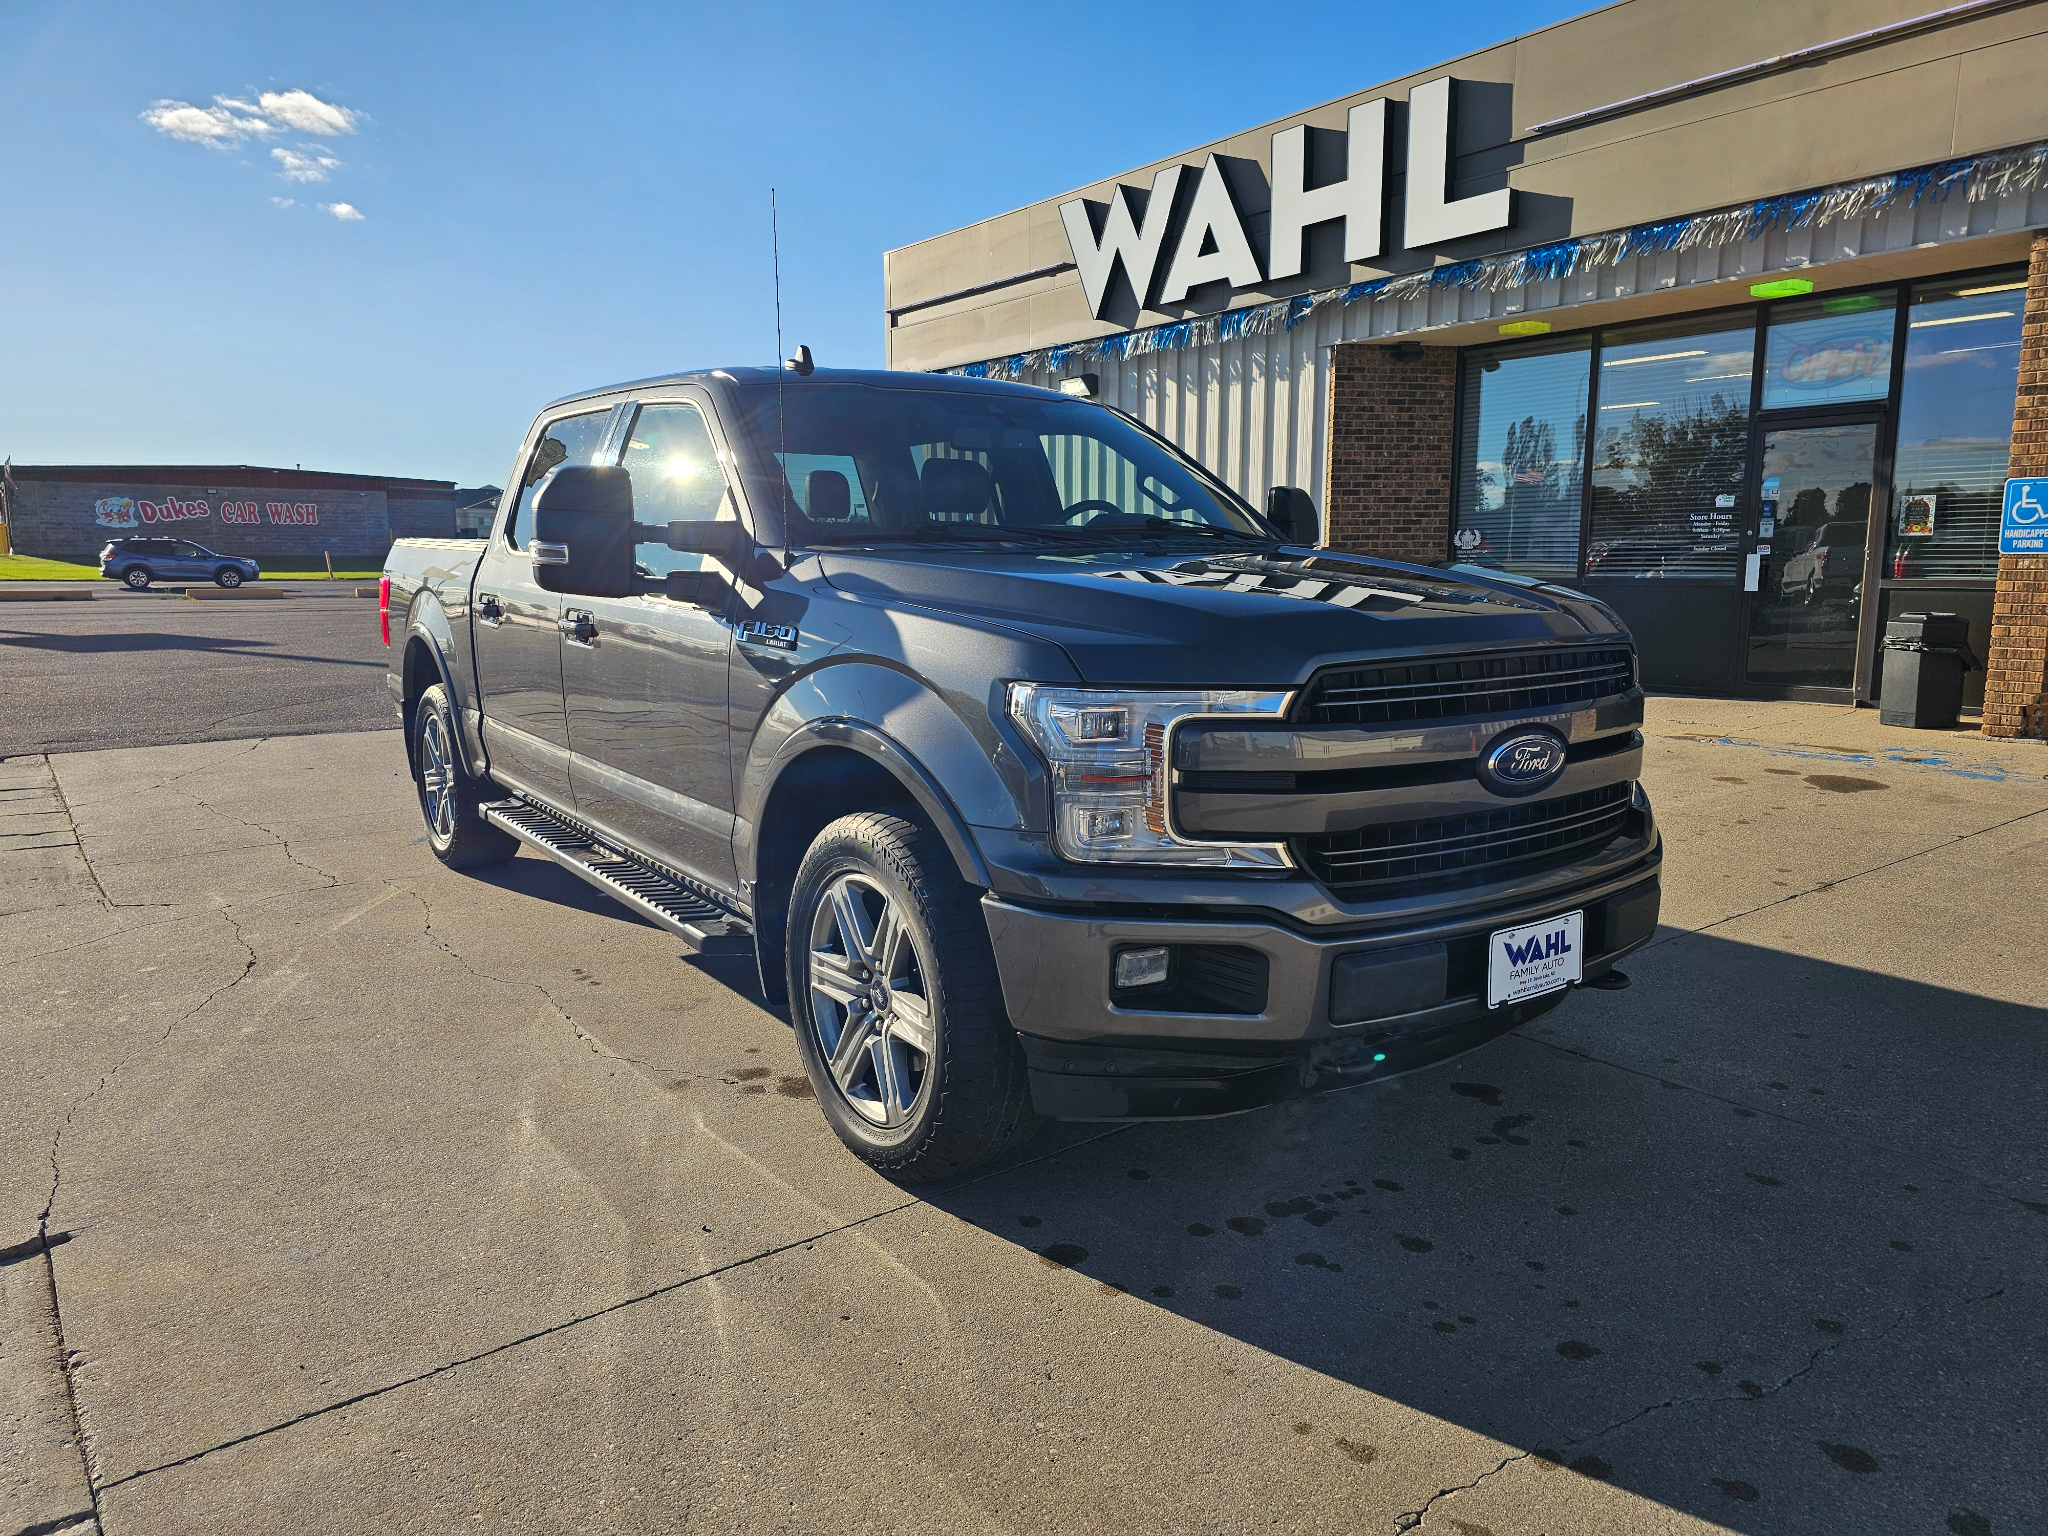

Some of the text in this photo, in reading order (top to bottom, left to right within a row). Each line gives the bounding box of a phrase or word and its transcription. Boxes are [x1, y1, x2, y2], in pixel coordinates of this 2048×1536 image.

[1058, 75, 1514, 320] WAHL
[1781, 339, 1880, 381] OPEN
[138, 497, 318, 525] Dukes CAR WASH
[1710, 512, 1732, 520] Hours
[2004, 529, 2048, 538] HANDICAPPE
[2012, 539, 2043, 548] PARKING
[765, 639, 787, 648] LARIAT
[1510, 746, 1551, 772] Ford
[1503, 930, 1571, 967] WAHL
[1509, 956, 1564, 980] FAMILY AUTO
